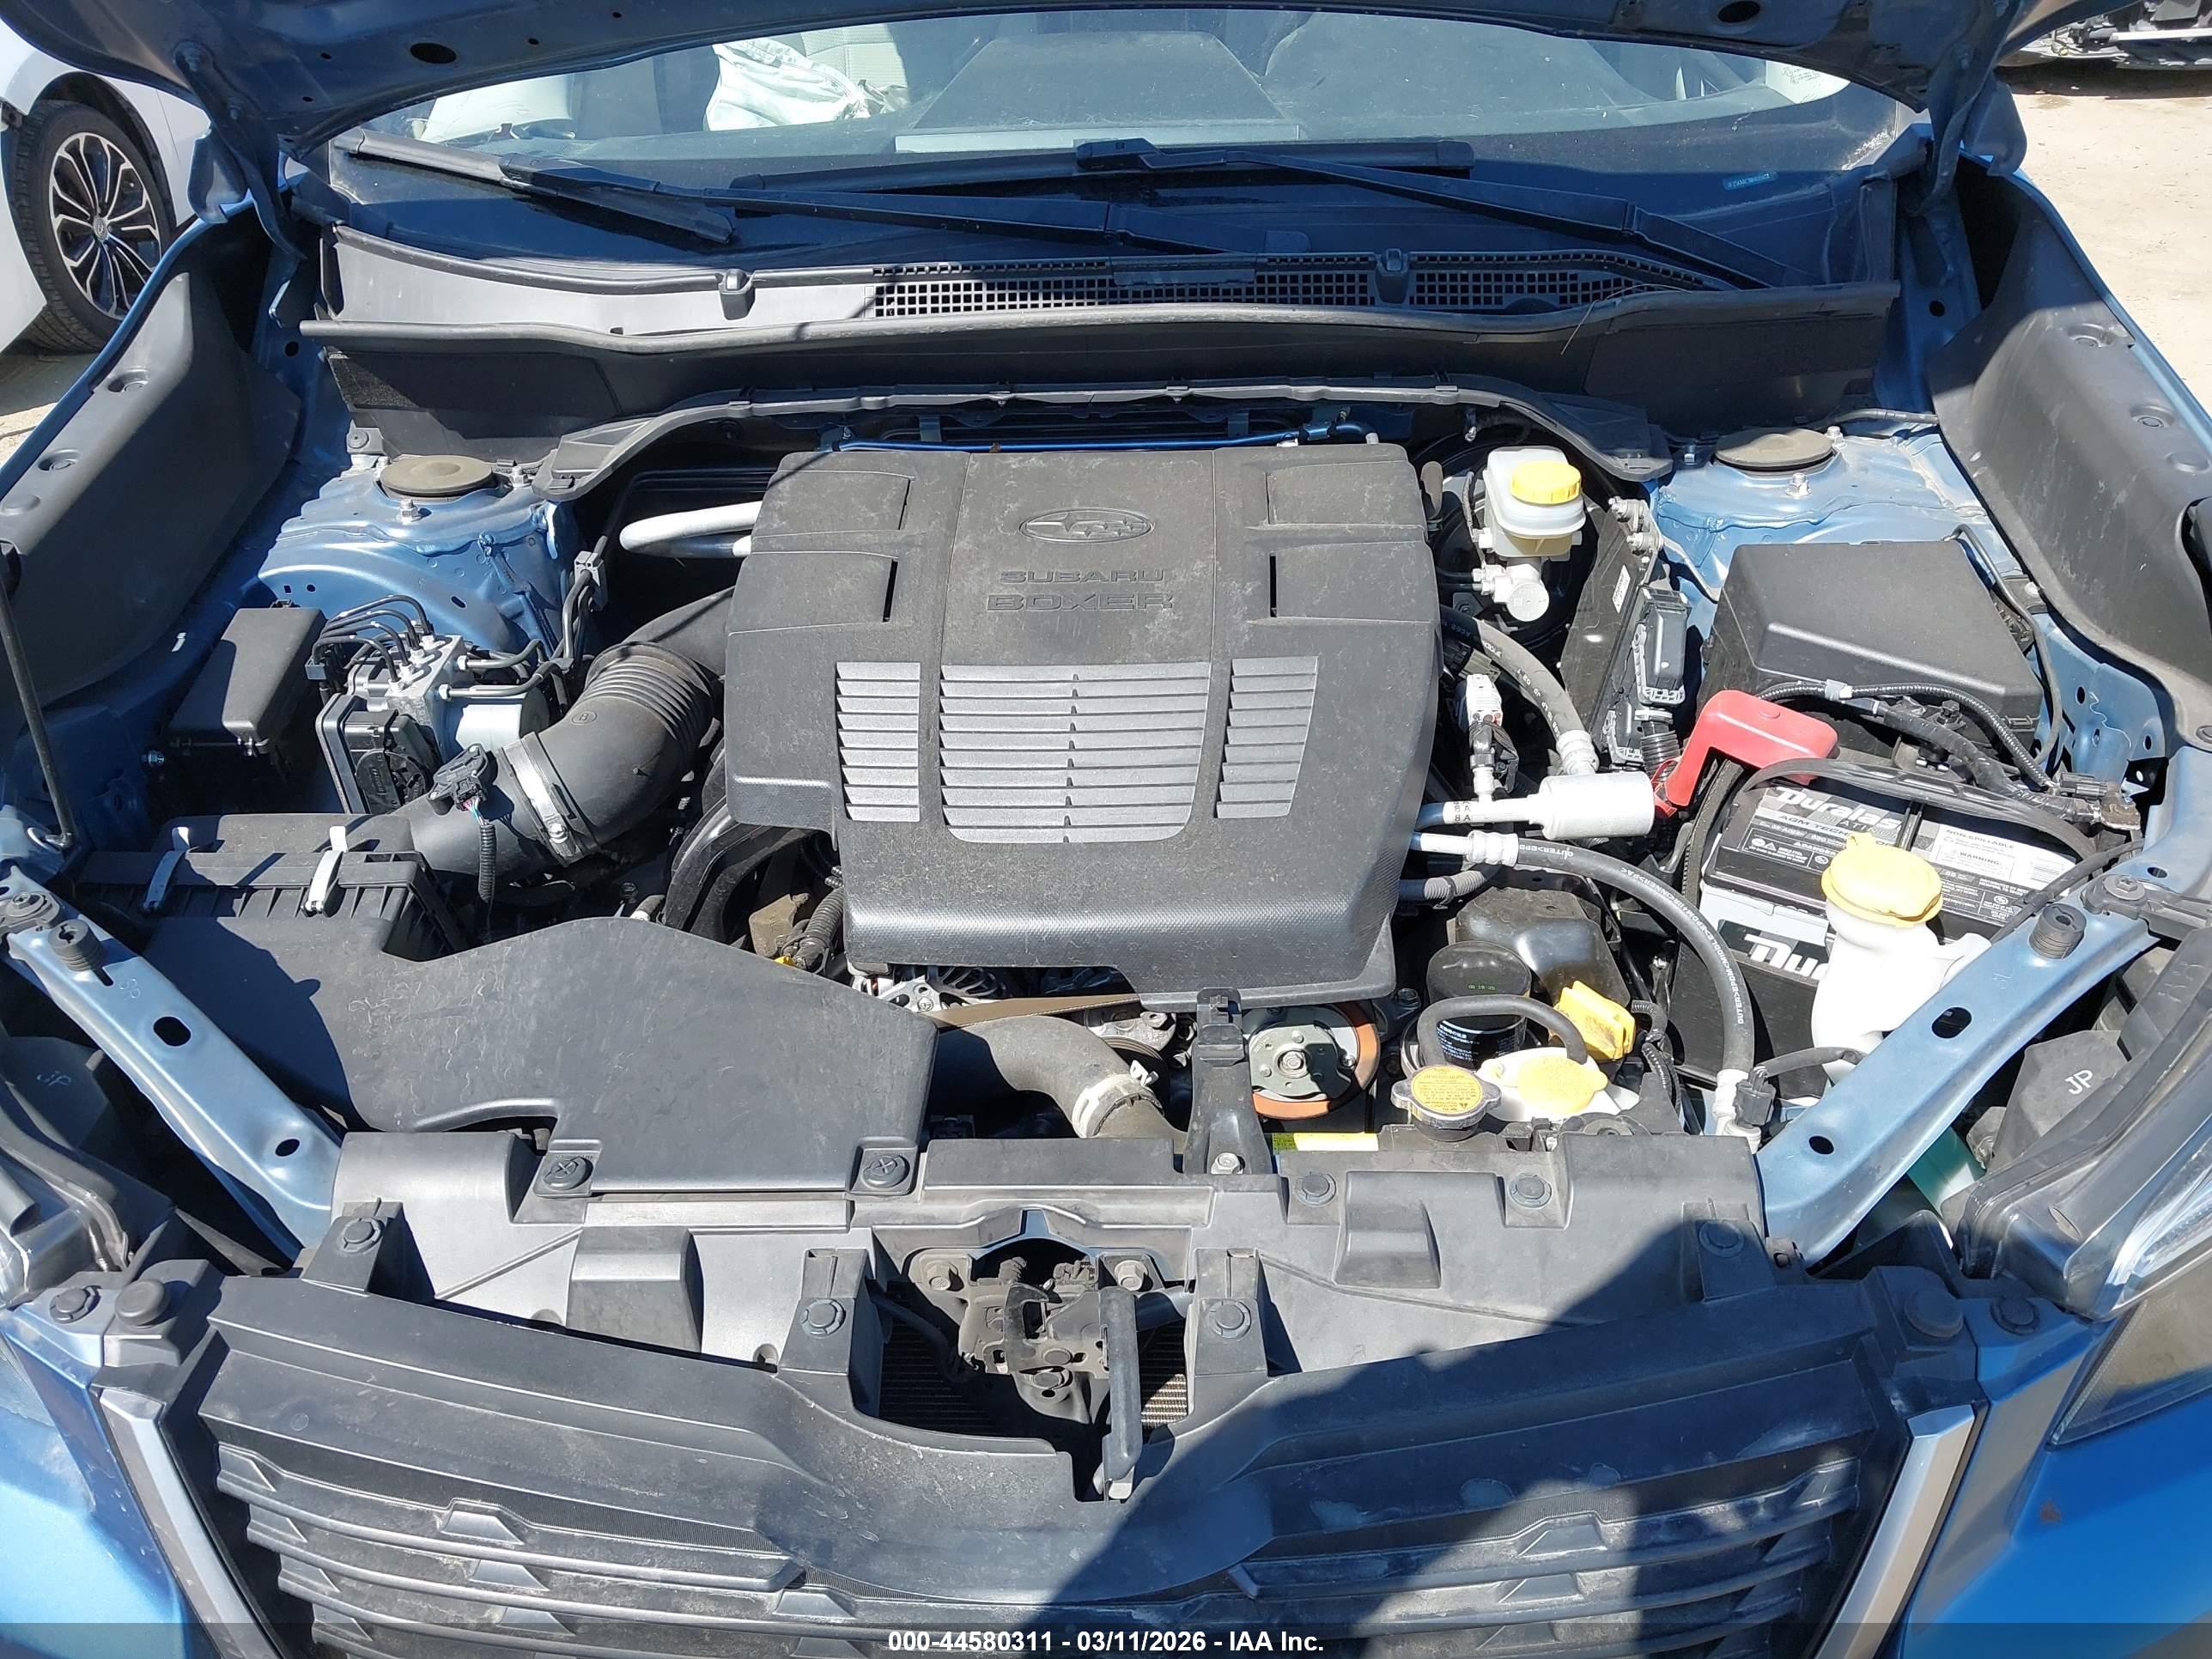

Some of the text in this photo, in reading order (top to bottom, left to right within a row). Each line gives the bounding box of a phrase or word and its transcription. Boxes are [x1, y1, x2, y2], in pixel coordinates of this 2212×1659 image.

[1000, 568, 1165, 584] SUBARU
[986, 592, 1175, 611] BOXER
[1776, 786, 1903, 830] Duralas
[2064, 1070, 2094, 1095] JP
